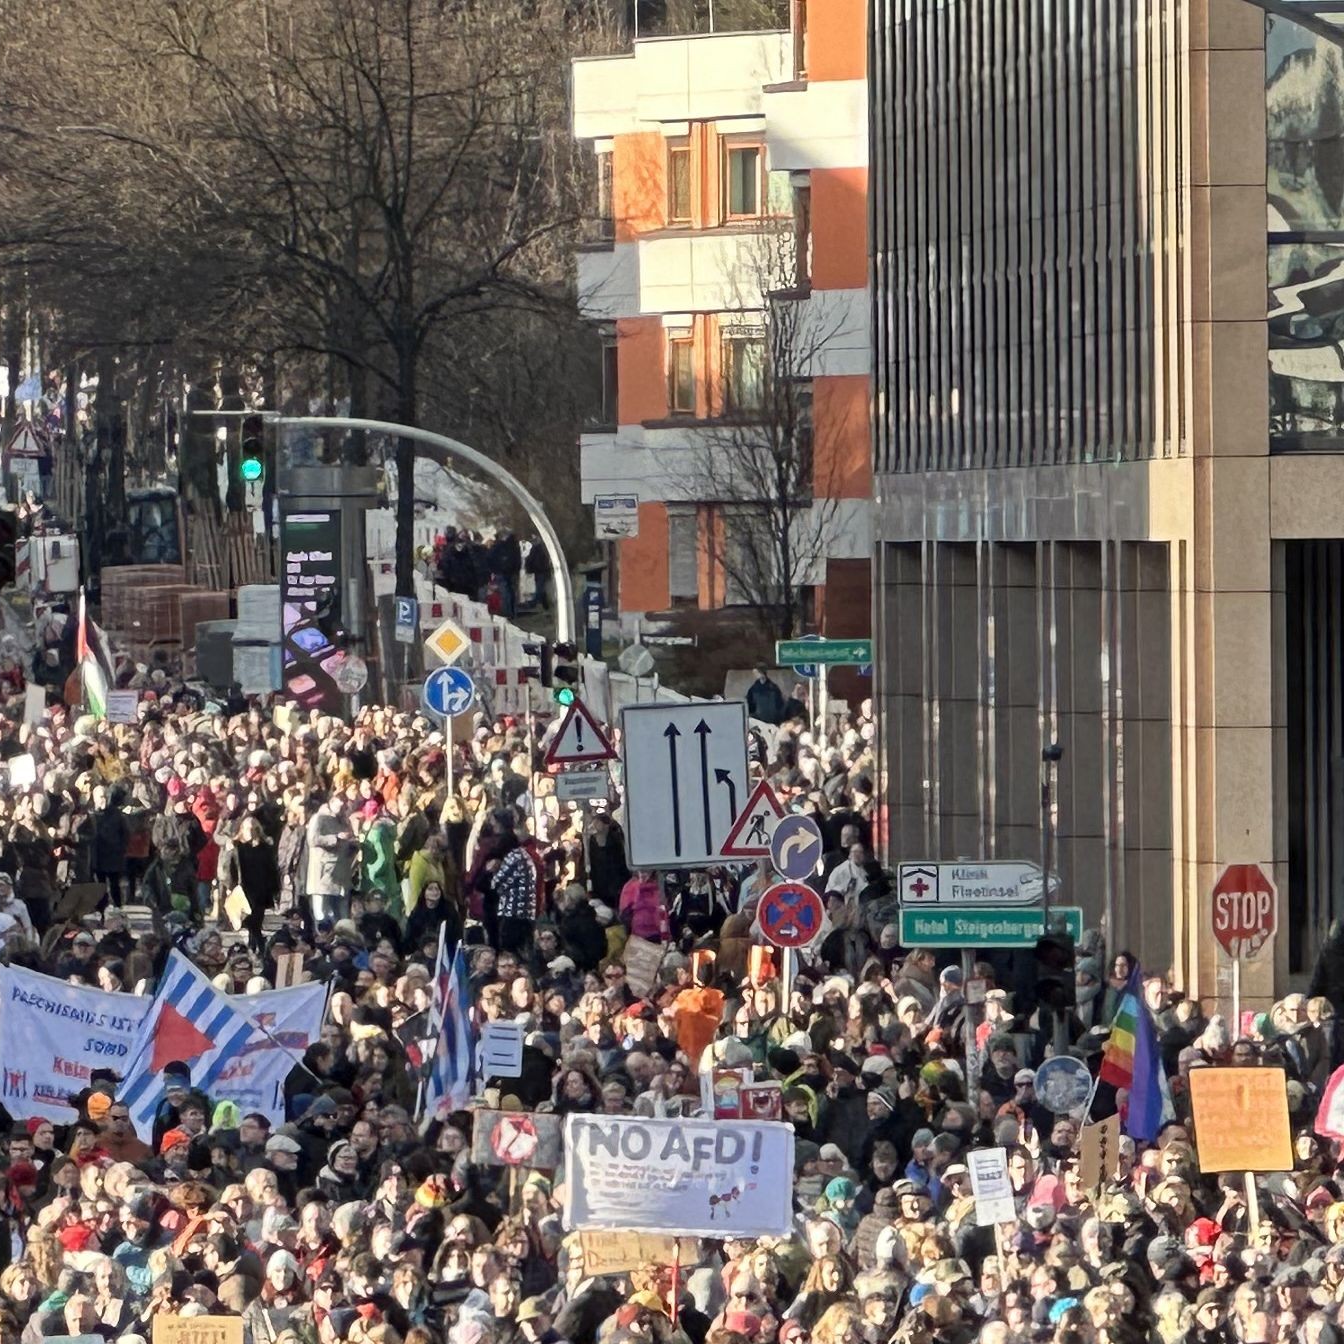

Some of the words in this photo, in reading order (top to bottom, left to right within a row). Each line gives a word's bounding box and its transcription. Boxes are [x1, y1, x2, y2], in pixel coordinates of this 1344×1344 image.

[955, 919, 1050, 938] Steigenberge
[1216, 891, 1271, 930] STOP
[589, 1122, 652, 1160] NO
